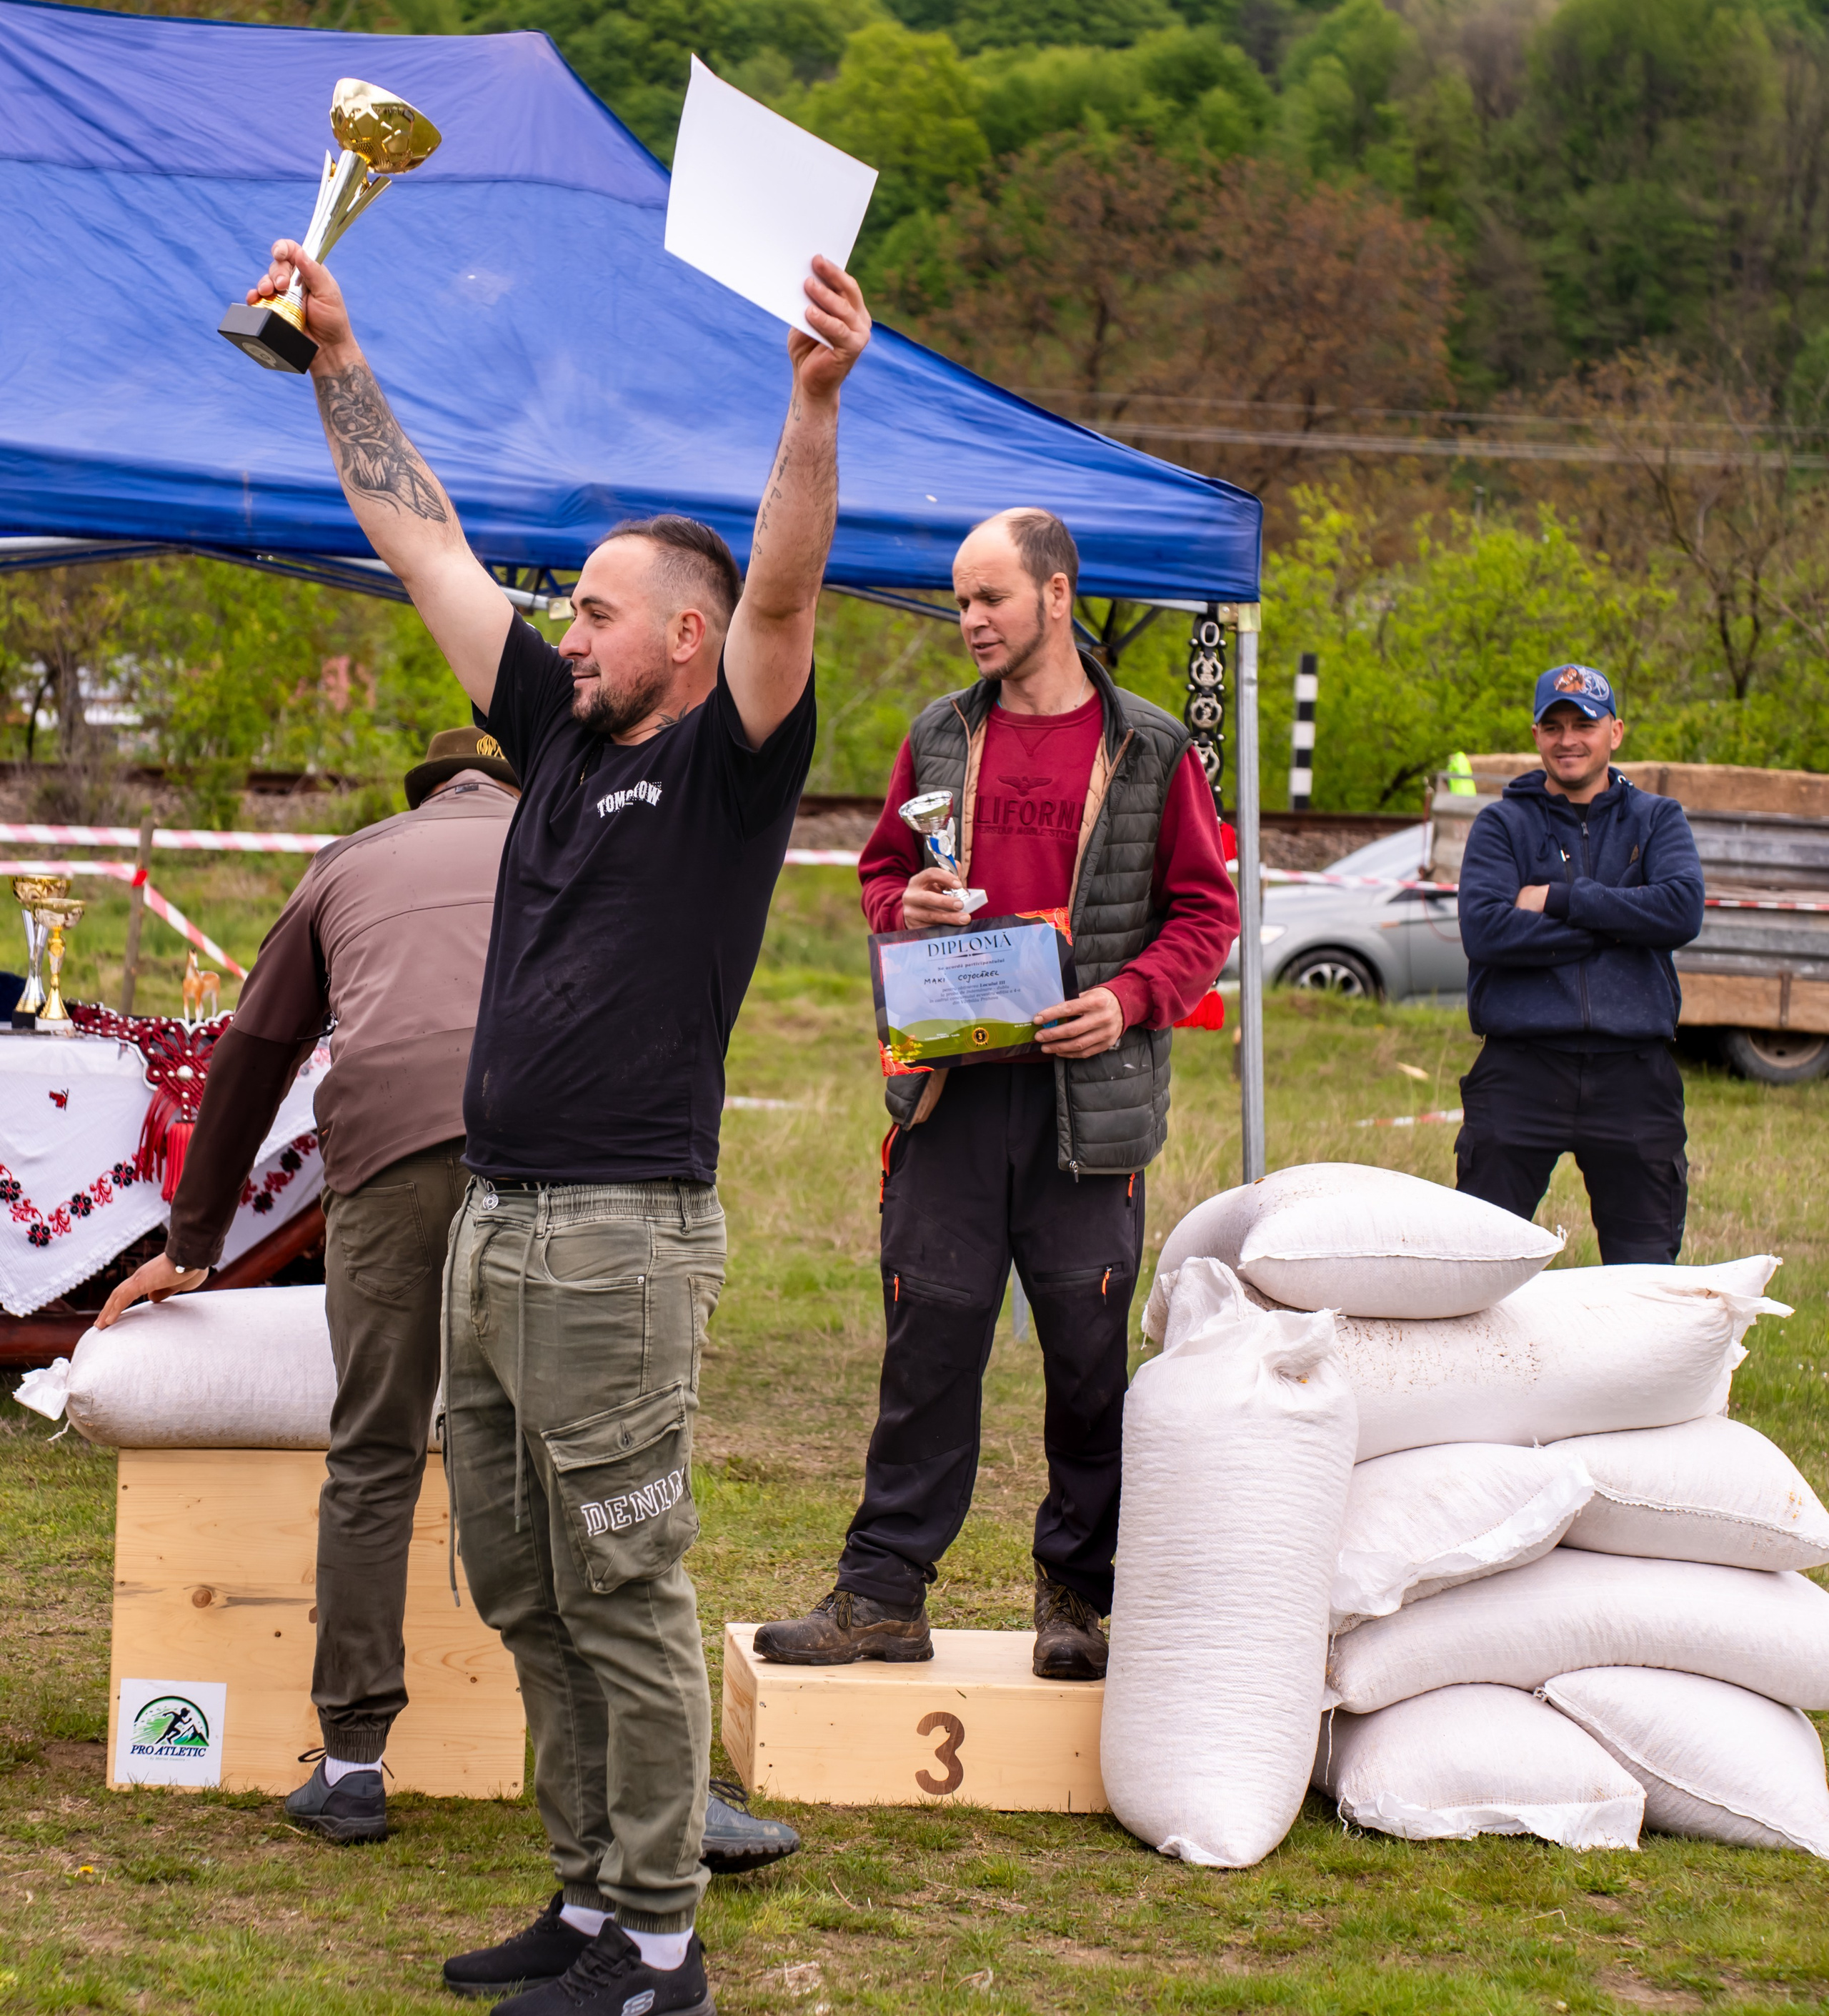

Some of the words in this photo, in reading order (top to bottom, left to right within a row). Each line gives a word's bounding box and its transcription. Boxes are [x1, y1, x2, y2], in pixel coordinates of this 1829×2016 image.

[975, 795, 1085, 831] LIFORNI
[928, 932, 1012, 957] DIPLOMĂ
[965, 959, 1005, 968] participantului
[130, 1745, 154, 1755] PRO
[154, 1746, 206, 1757] ATLETIC
[914, 1711, 965, 1795] 3
